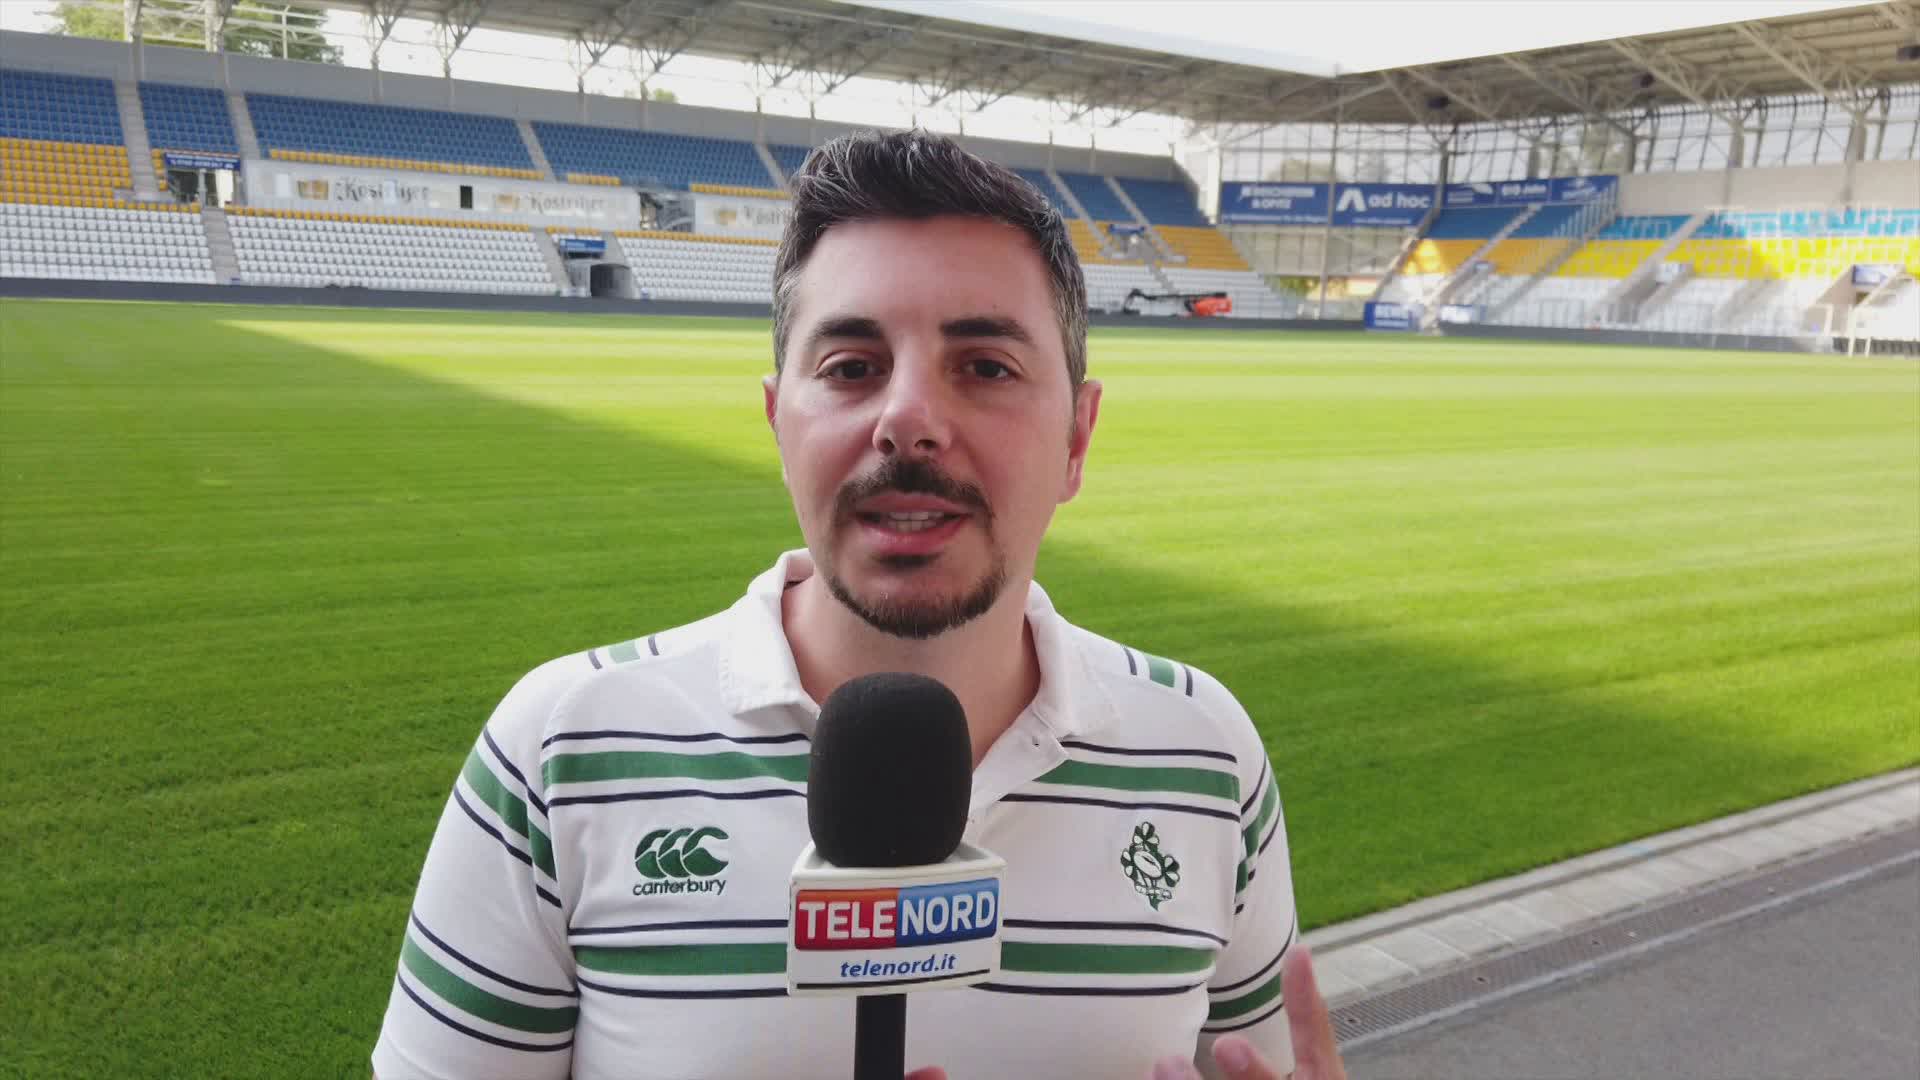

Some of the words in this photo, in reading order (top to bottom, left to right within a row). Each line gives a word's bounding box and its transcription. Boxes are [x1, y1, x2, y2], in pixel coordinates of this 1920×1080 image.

[1368, 191, 1393, 208] ad
[1396, 191, 1430, 208] hoc
[632, 879, 727, 897] canterbury
[840, 953, 957, 978] telenord.it
